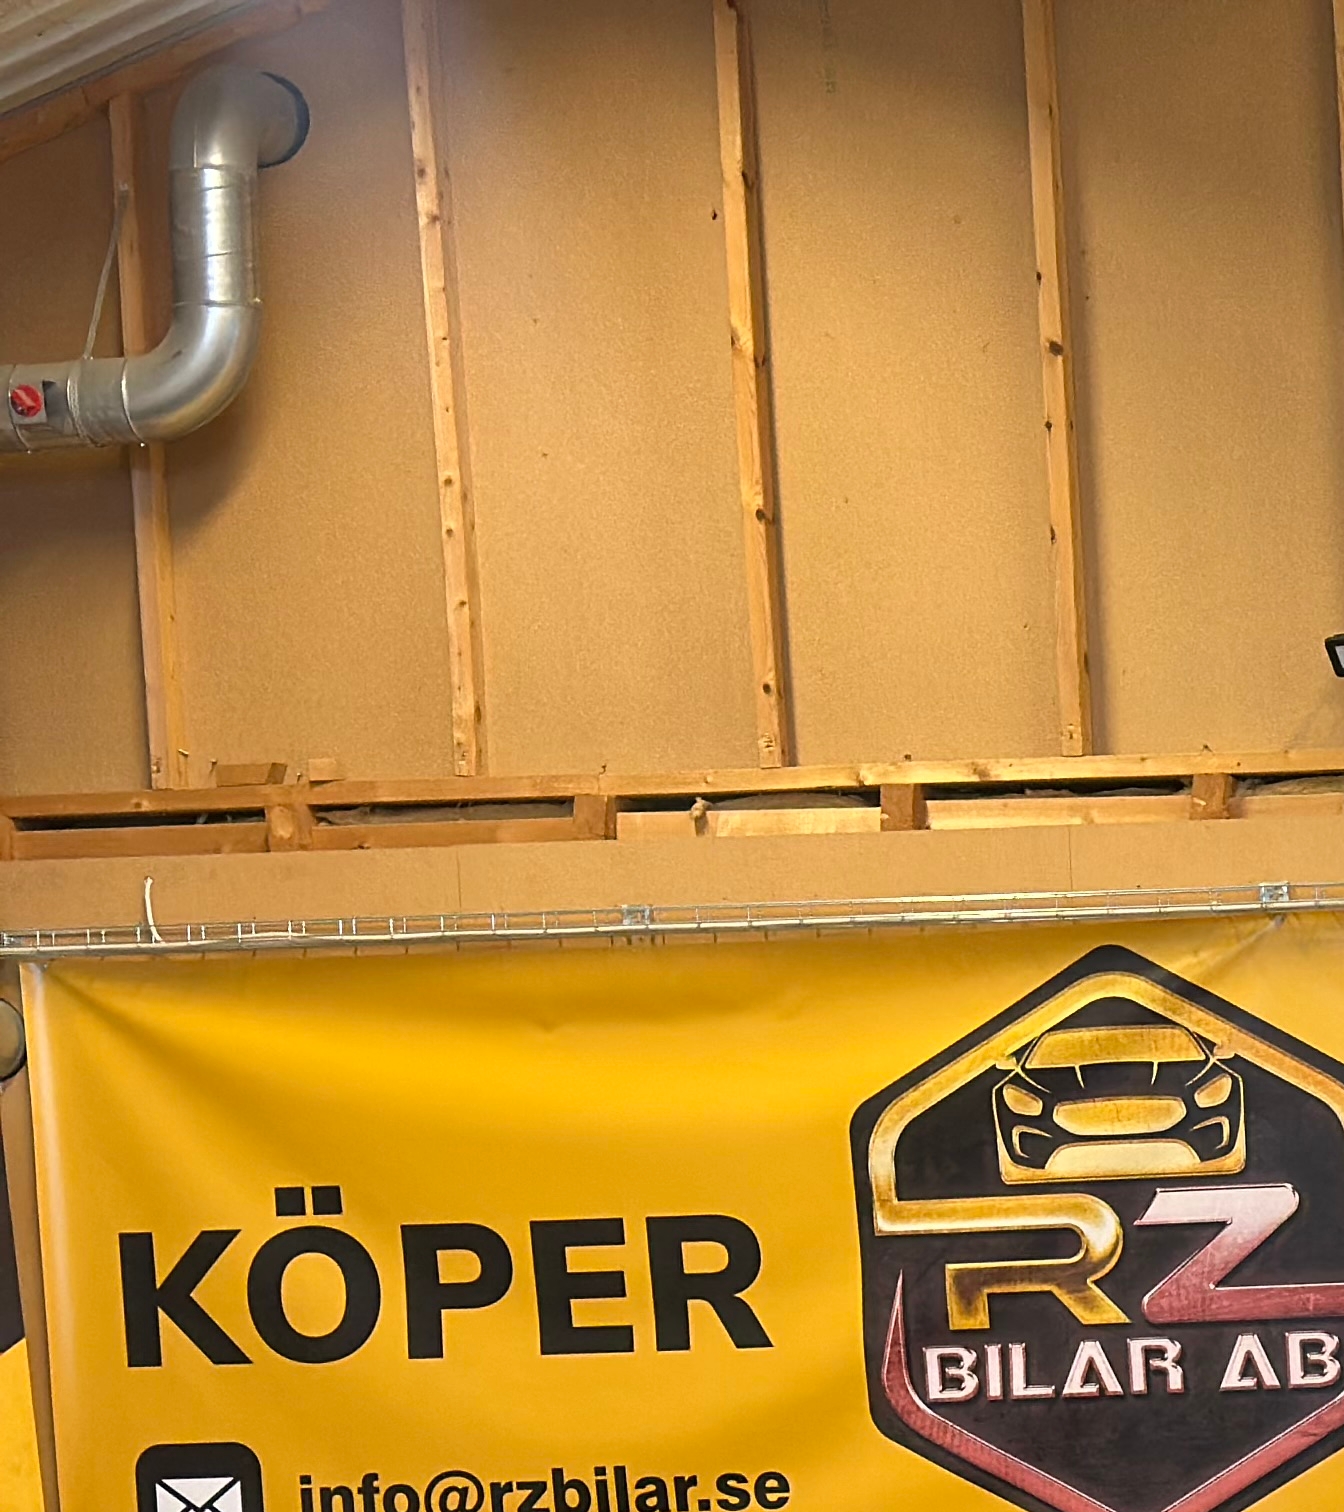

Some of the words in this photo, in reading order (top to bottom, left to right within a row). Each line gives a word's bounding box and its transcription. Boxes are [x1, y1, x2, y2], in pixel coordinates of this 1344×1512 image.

[118, 1186, 774, 1367] KÖPER
[921, 1336, 1184, 1403] BILAR
[1218, 1330, 1342, 1391] AB
